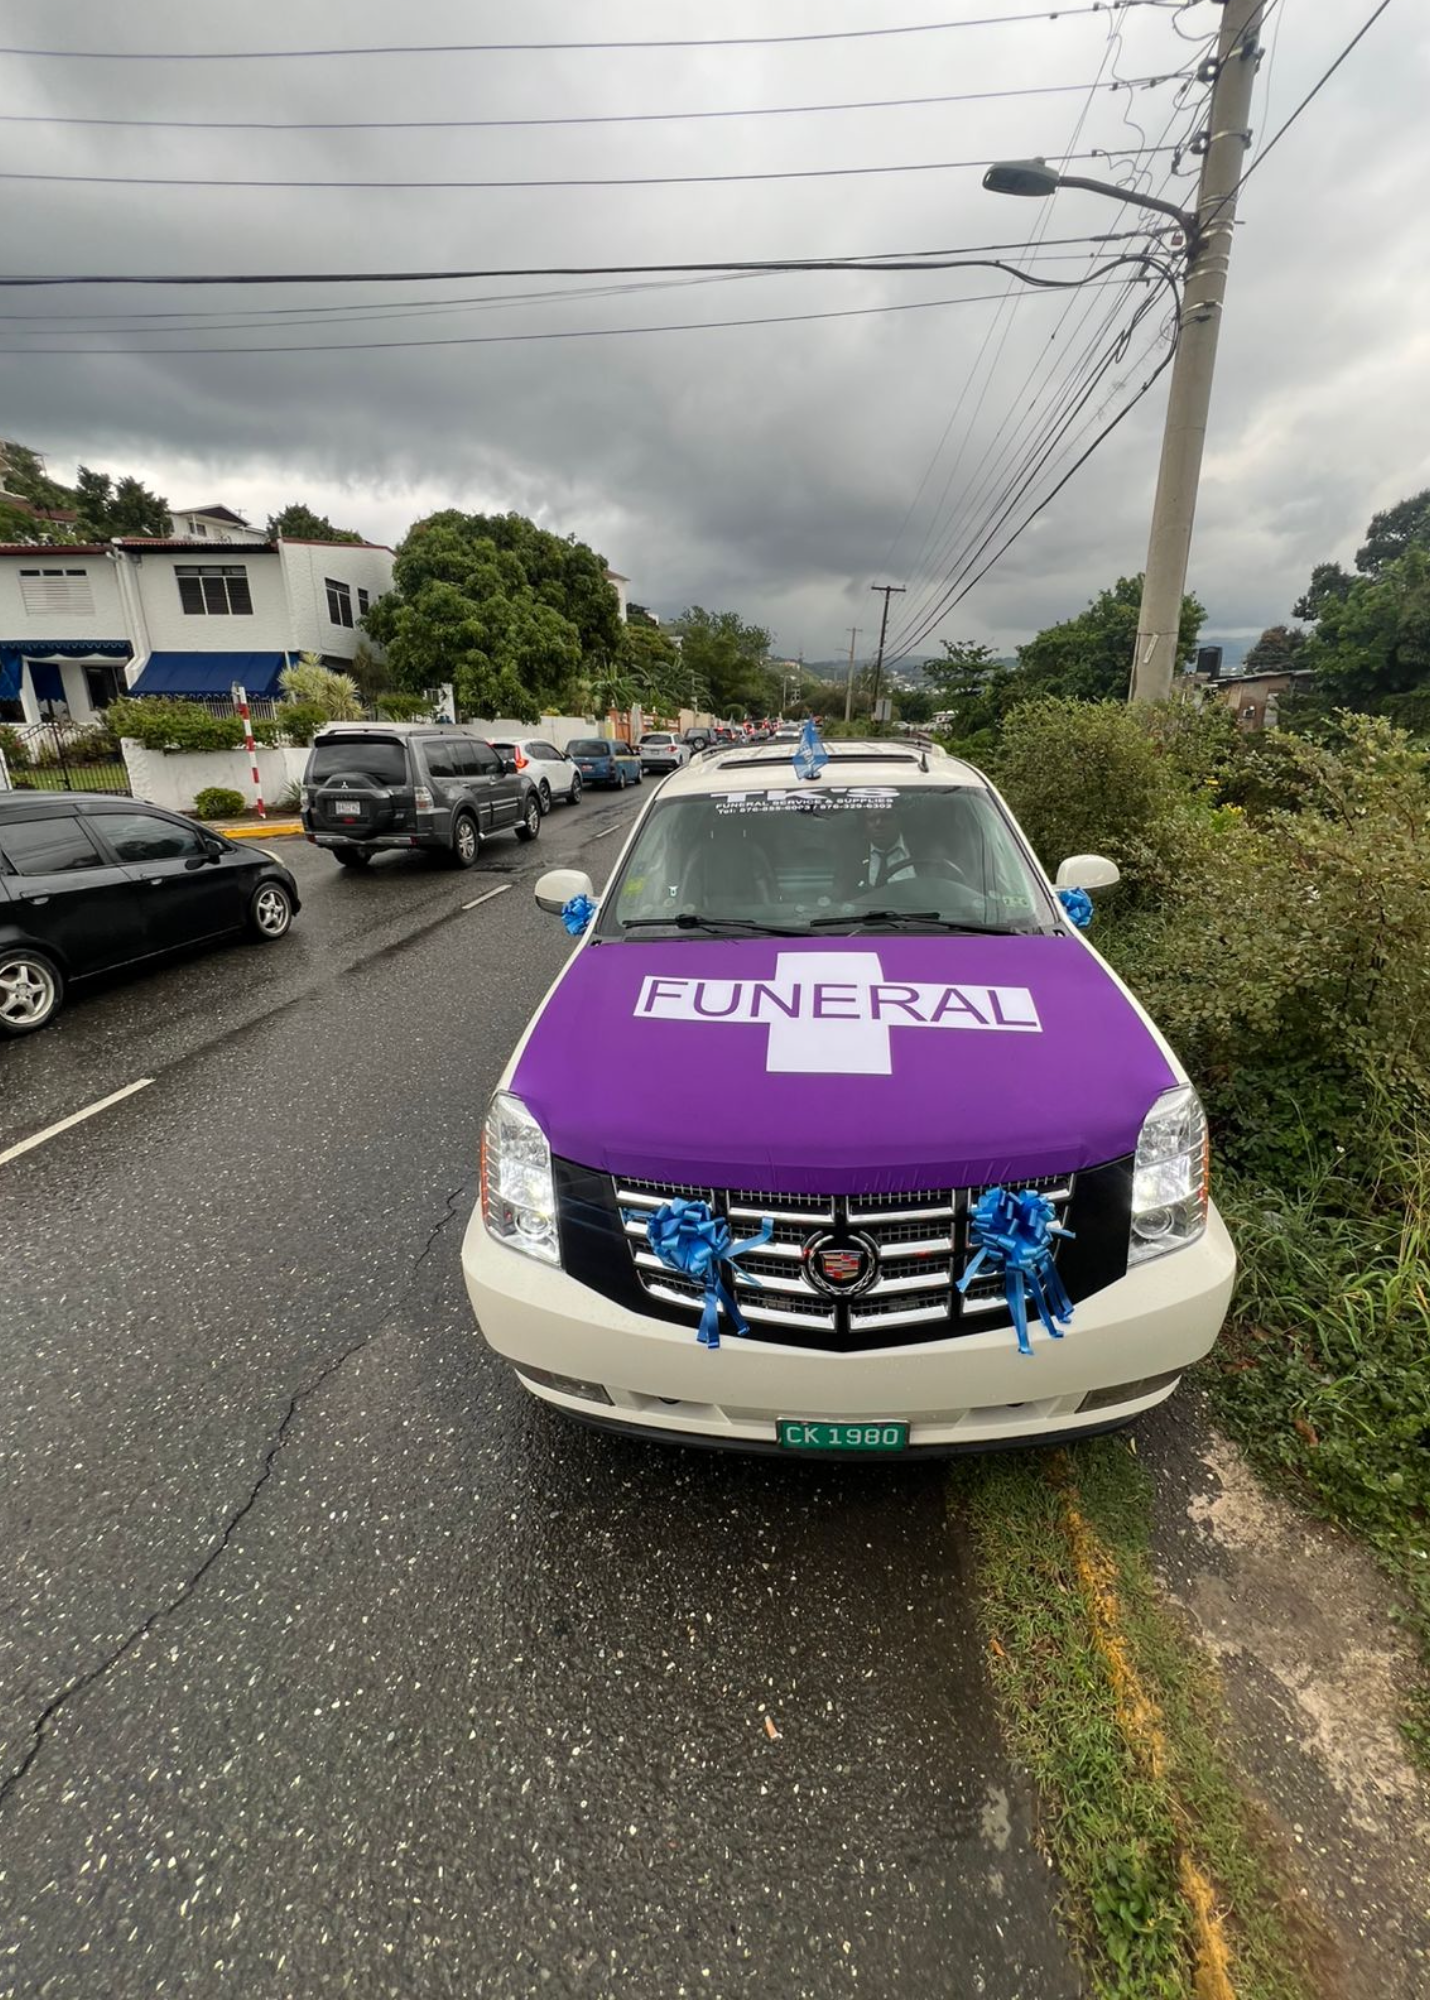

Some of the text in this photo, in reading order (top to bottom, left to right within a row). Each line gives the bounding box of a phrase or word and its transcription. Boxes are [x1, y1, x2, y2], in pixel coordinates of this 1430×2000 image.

[710, 788, 900, 803] TK'S
[716, 800, 769, 809] FUNERAL
[643, 979, 1037, 1027] FUNERAL
[785, 1426, 899, 1445] CK 1980
